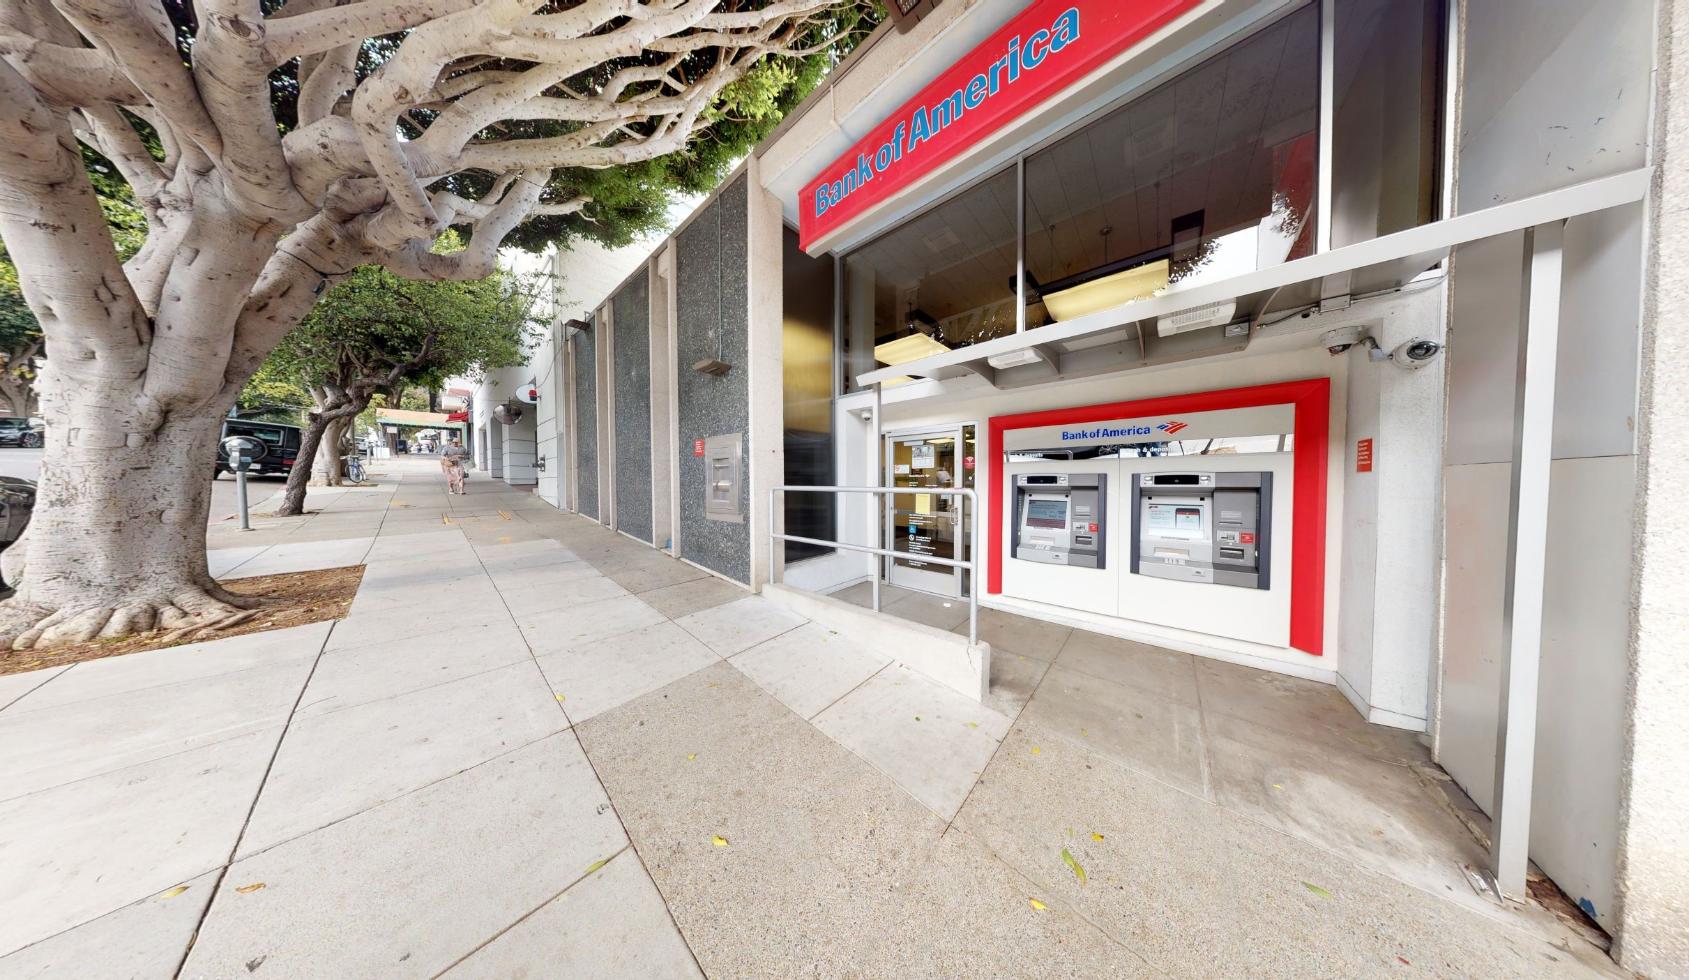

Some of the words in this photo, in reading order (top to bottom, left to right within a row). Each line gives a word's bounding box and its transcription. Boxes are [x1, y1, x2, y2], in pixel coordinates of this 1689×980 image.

[815, 153, 874, 217] Bank
[875, 121, 905, 172] of
[908, 7, 1080, 151] America
[1062, 430, 1088, 441] Bank
[1089, 429, 1101, 439] of
[1102, 426, 1151, 437] America
